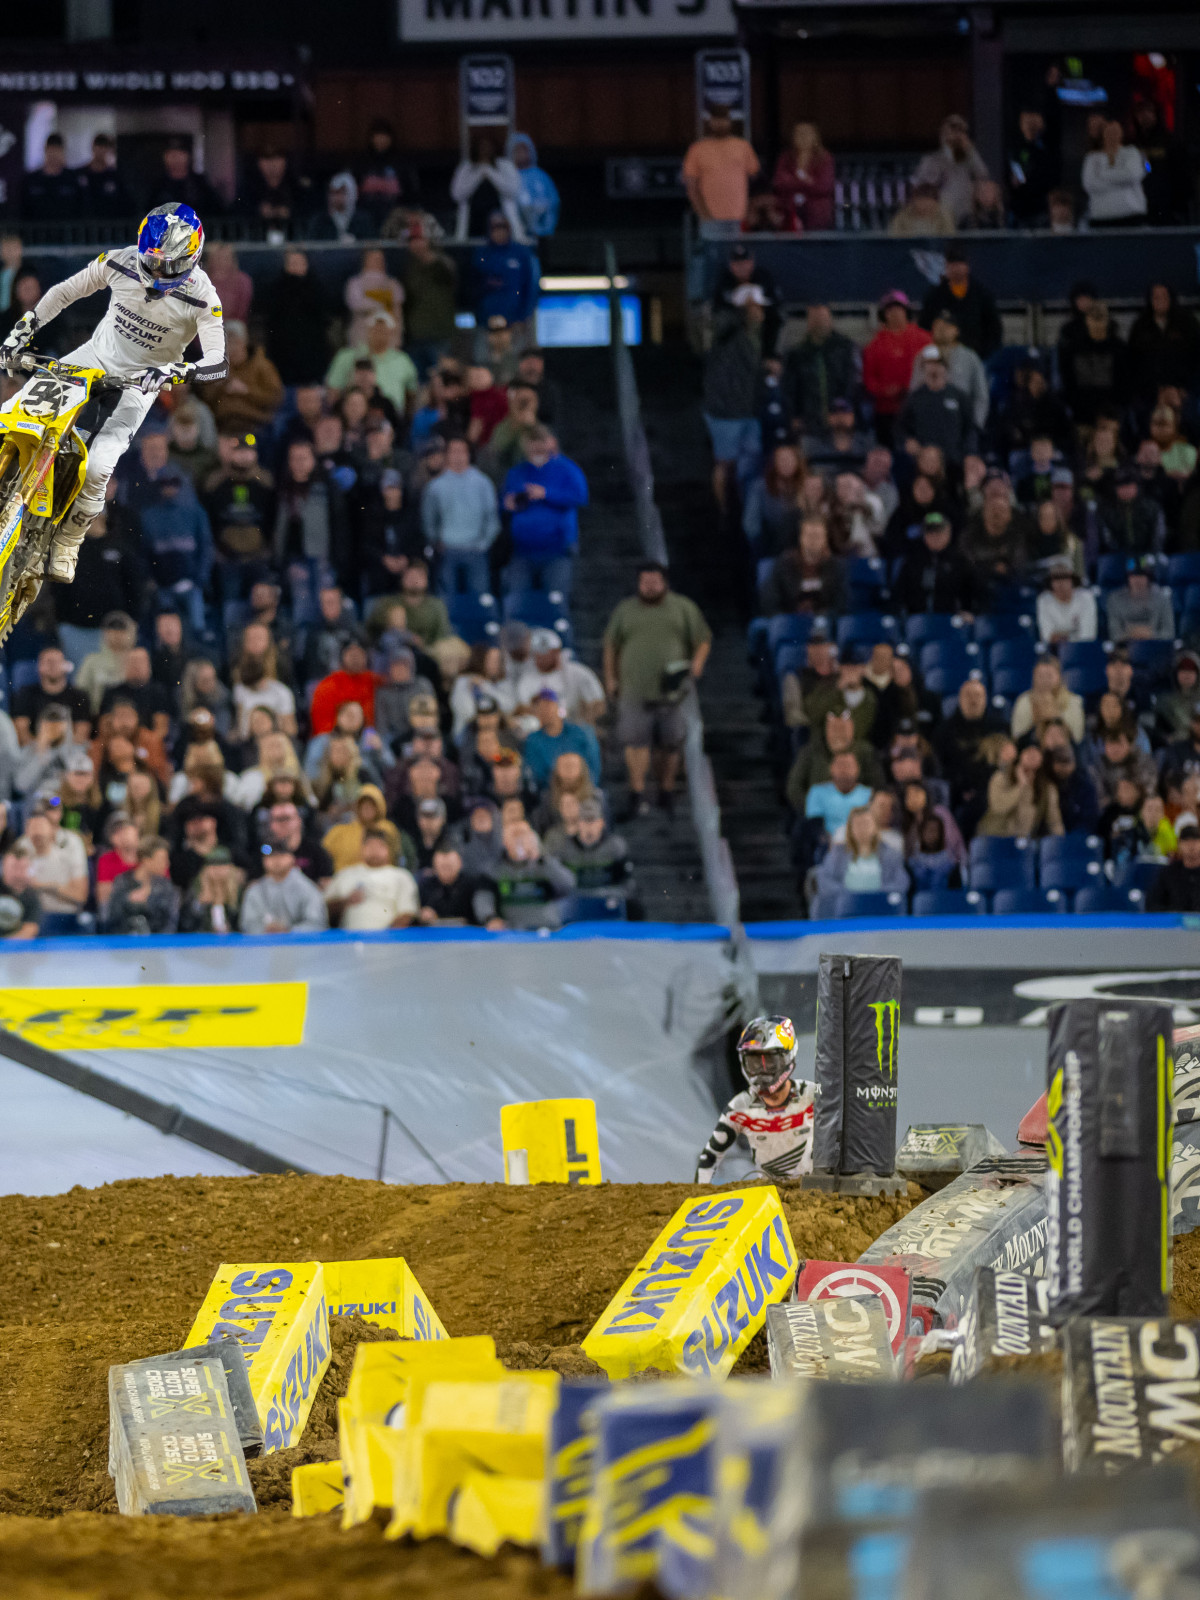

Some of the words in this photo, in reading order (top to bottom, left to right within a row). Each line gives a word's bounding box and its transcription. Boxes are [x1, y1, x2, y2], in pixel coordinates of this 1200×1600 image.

[84, 72, 165, 90] WHOLE
[171, 72, 225, 90] HOG
[114, 302, 171, 334] PROGRESSIVE
[115, 315, 162, 344] SUZUKI
[114, 324, 155, 352] ECSTAR
[21, 381, 73, 411] 94
[856, 1085, 897, 1100] MONST
[1065, 1051, 1082, 1214] CHAMPIONSHIP
[603, 1198, 744, 1335] SUZUKI
[1066, 1216, 1083, 1294] WORLD
[207, 1269, 294, 1352] SUZ
[328, 1301, 396, 1316] UZUKI
[683, 1215, 794, 1378] SUZUKI
[991, 1272, 1031, 1355] OUNTAIN
[784, 1304, 829, 1380] MOUNTAIN
[145, 1369, 166, 1398] CROSS
[163, 1370, 184, 1396] MOTO
[181, 1367, 202, 1396] SUPER
[265, 1295, 331, 1451] SUZUKI
[1091, 1319, 1142, 1460] MOUNTAIN
[161, 1435, 182, 1464] CROSS
[180, 1436, 200, 1462] MOTO
[197, 1432, 218, 1462] SUPER
